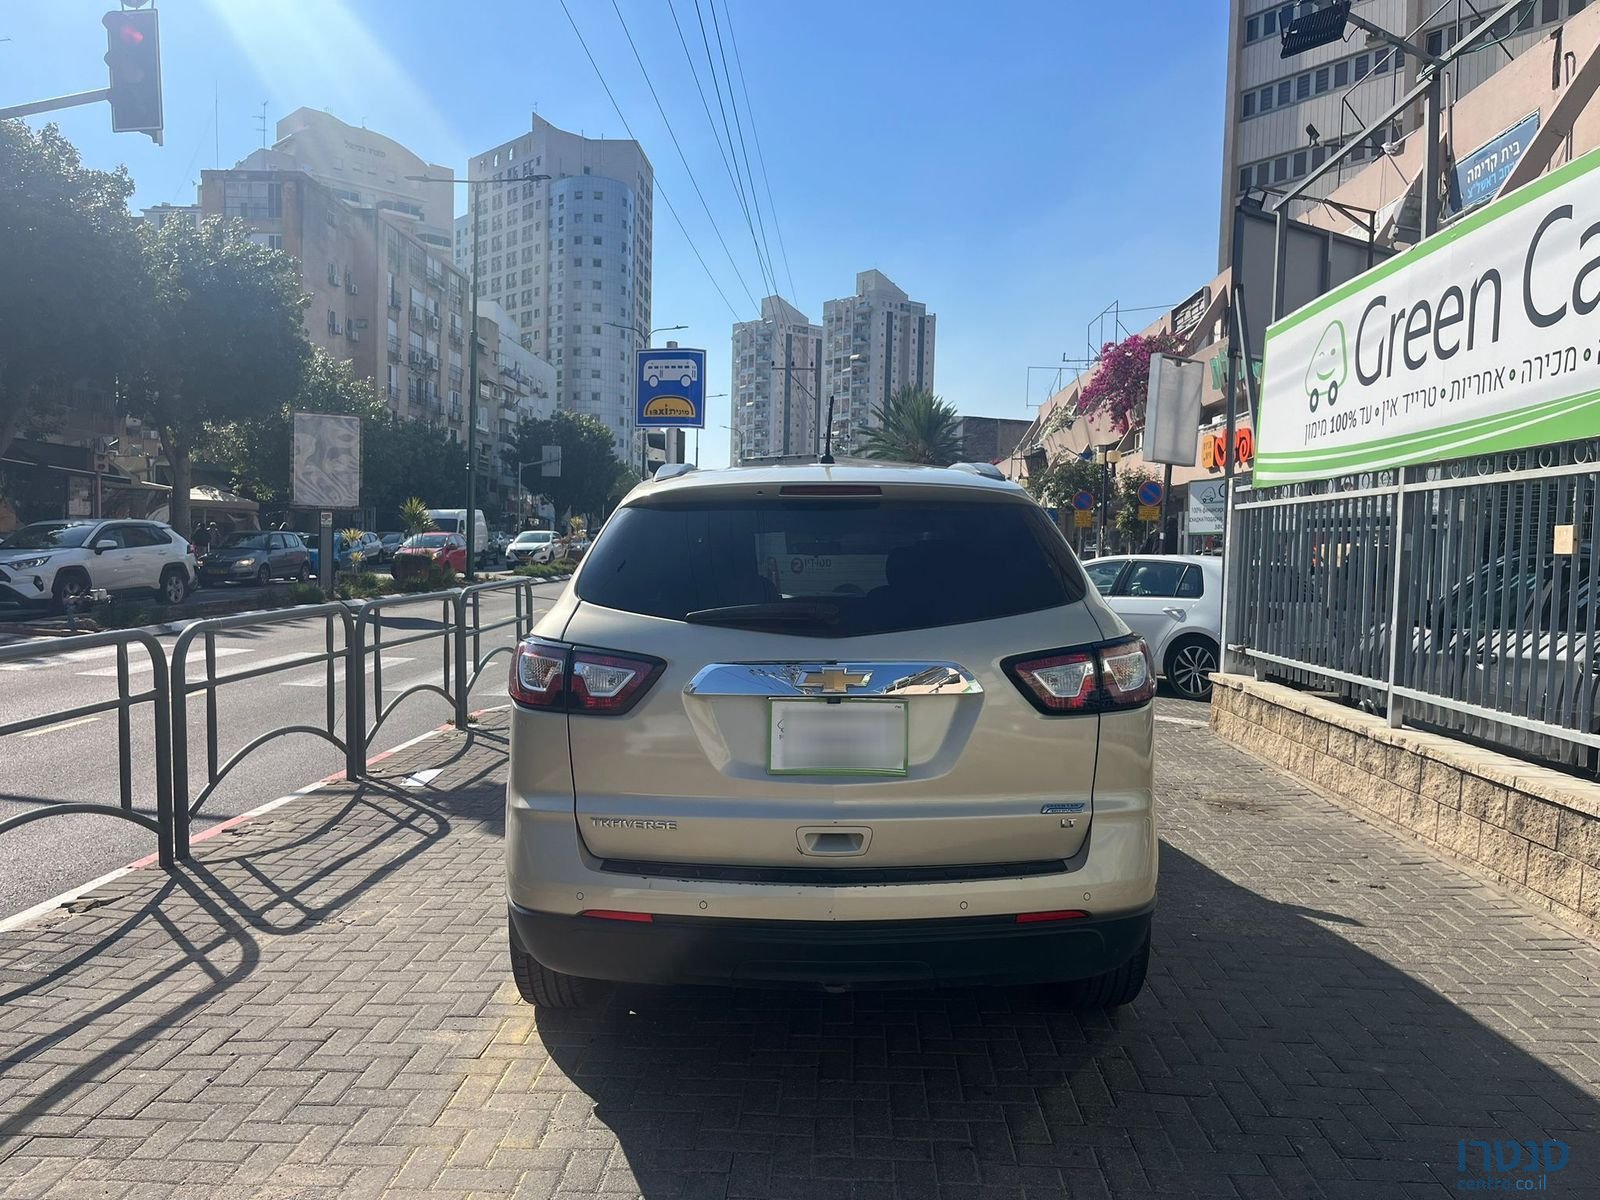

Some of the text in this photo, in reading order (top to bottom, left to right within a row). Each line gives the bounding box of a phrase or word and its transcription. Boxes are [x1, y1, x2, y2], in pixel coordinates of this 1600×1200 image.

[1501, 141, 1520, 163] בית
[1355, 268, 1502, 387] Green
[1305, 346, 1577, 446] מכירה אחריות טרייד אין עד 100% מימון
[590, 817, 678, 830] TRAVERSE
